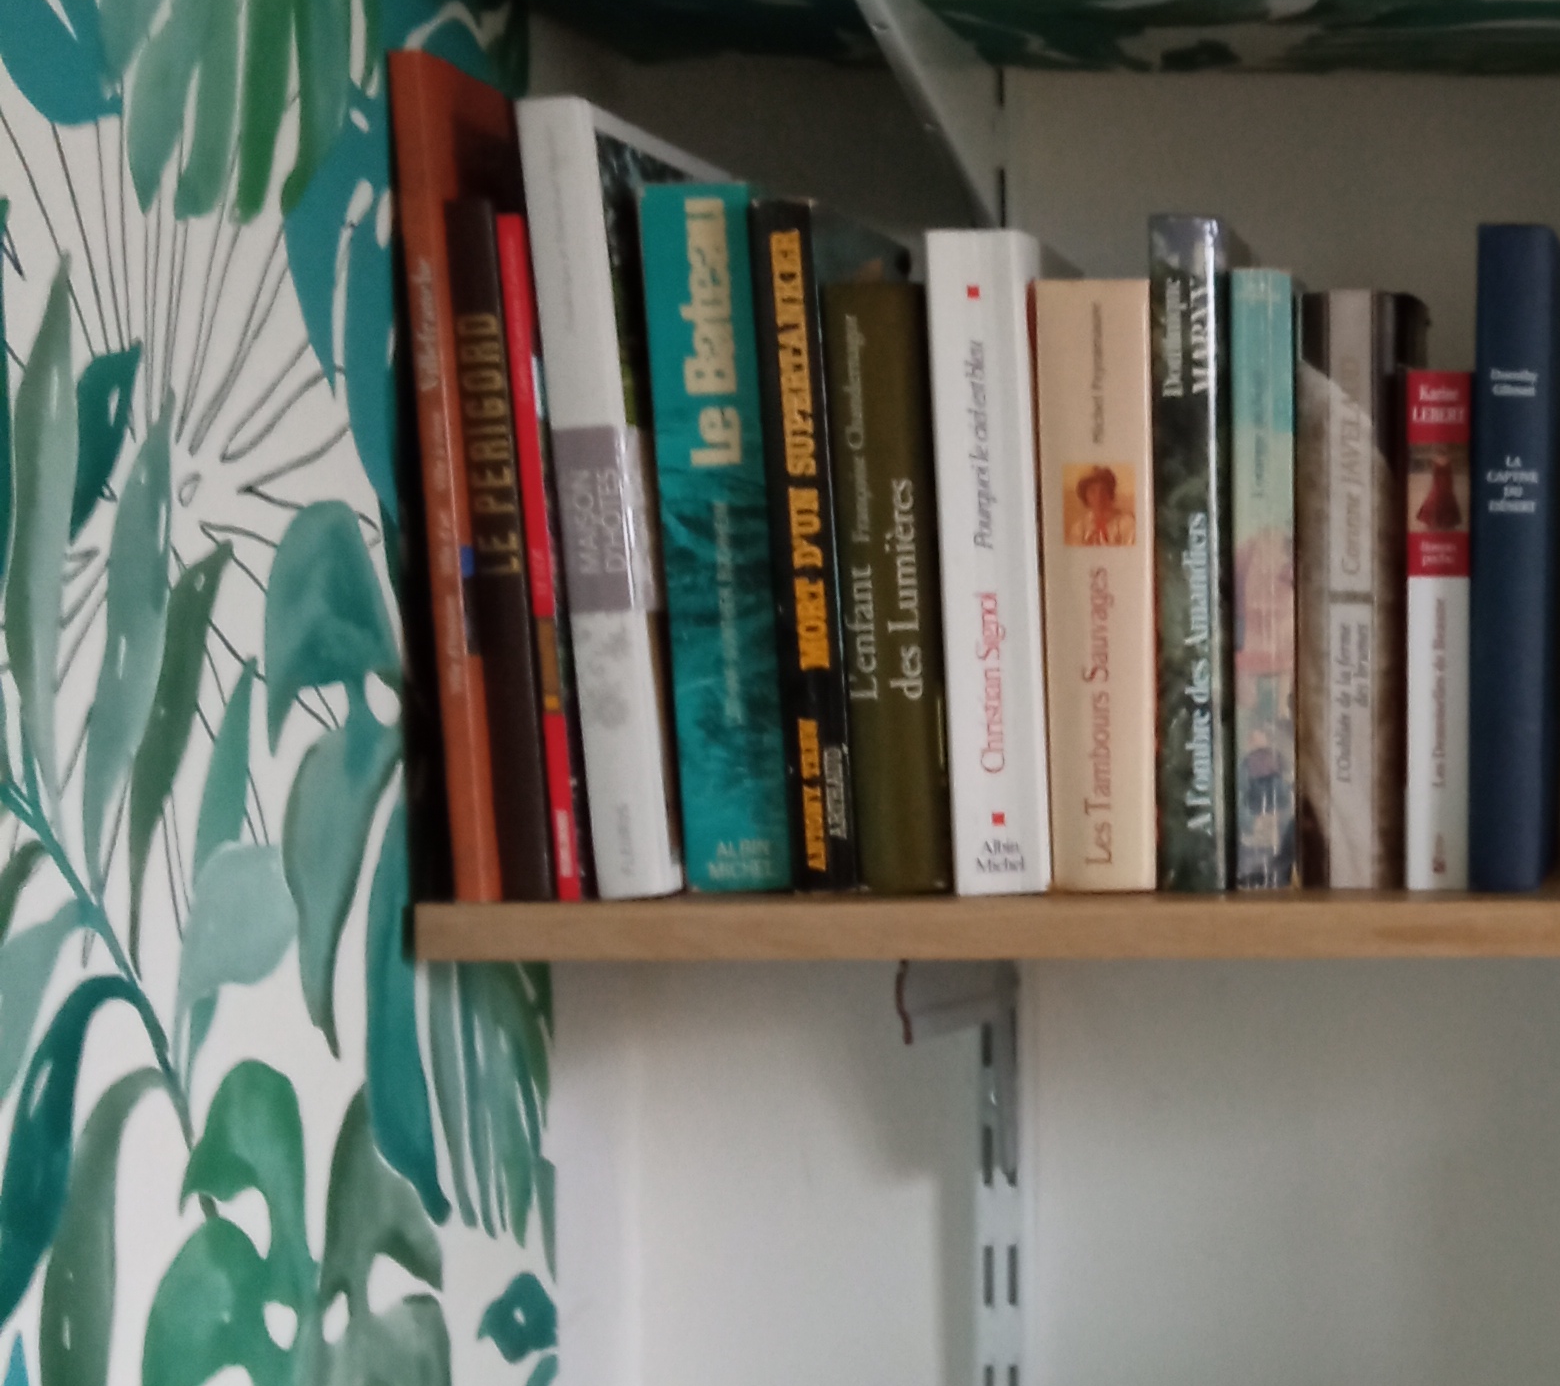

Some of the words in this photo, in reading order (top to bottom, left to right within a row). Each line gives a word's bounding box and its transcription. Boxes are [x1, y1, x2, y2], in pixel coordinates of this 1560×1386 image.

[680, 197, 737, 396] Bateau
[769, 226, 818, 477] SUPERTANKER
[963, 339, 986, 381] bleu
[690, 407, 742, 467] Le
[484, 532, 522, 576] LE
[572, 469, 601, 575] MAISON
[788, 485, 823, 567] D'UN
[884, 478, 921, 631] Lumières
[971, 465, 998, 550] Pourquoi
[1339, 492, 1363, 576] Corinne
[794, 577, 832, 670] MORT
[974, 589, 1007, 661] Signol
[1080, 565, 1113, 683] Sauvages
[1180, 512, 1210, 653] Amandiers
[848, 562, 881, 700] L'enfant
[889, 644, 926, 700] des
[977, 666, 1007, 774] Christian
[1183, 658, 1210, 703] des
[825, 745, 848, 840] ARTHAUD
[1082, 690, 1115, 816] Tambours
[1183, 708, 1212, 807] l'ombre
[1084, 822, 1115, 865] Les
